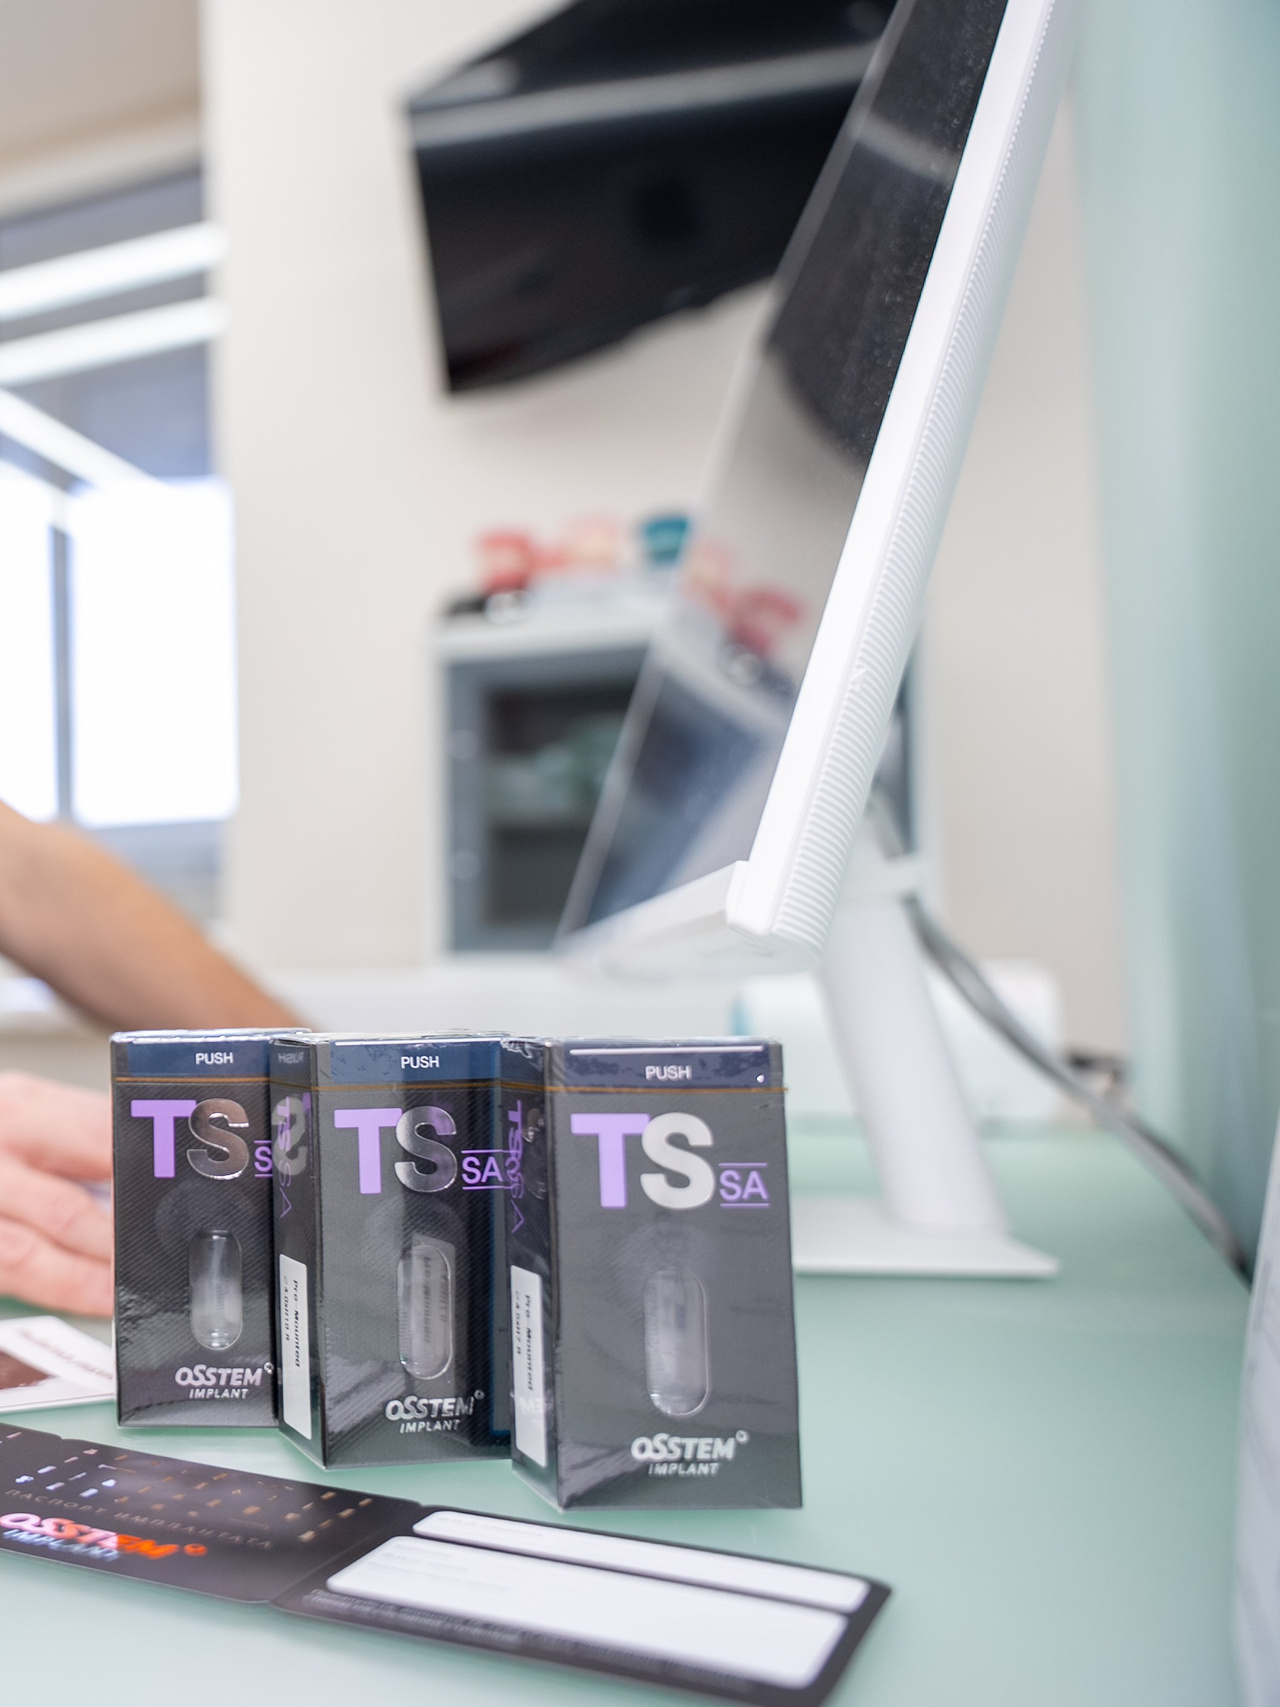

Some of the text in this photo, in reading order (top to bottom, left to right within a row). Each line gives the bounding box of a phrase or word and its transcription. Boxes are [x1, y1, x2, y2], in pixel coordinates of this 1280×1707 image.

[195, 1052, 234, 1065] PUSH
[400, 1056, 440, 1068] PUSH
[645, 1065, 692, 1081] PUSH
[130, 1098, 250, 1180] TS
[334, 1105, 504, 1194] TS SA
[570, 1112, 769, 1210] TS SA
[175, 1364, 265, 1386] OSSTEM
[189, 1387, 249, 1400] IMPLANT
[385, 1395, 475, 1421] OSSTEM
[400, 1419, 461, 1434] IMPLANT
[630, 1433, 738, 1462] OSSTEM
[648, 1462, 719, 1477] IMPLANT
[5, 1489, 273, 1548] ПАСПОРТ ИМПЛАНТАТА
[2, 1529, 119, 1561] IMPLANT
